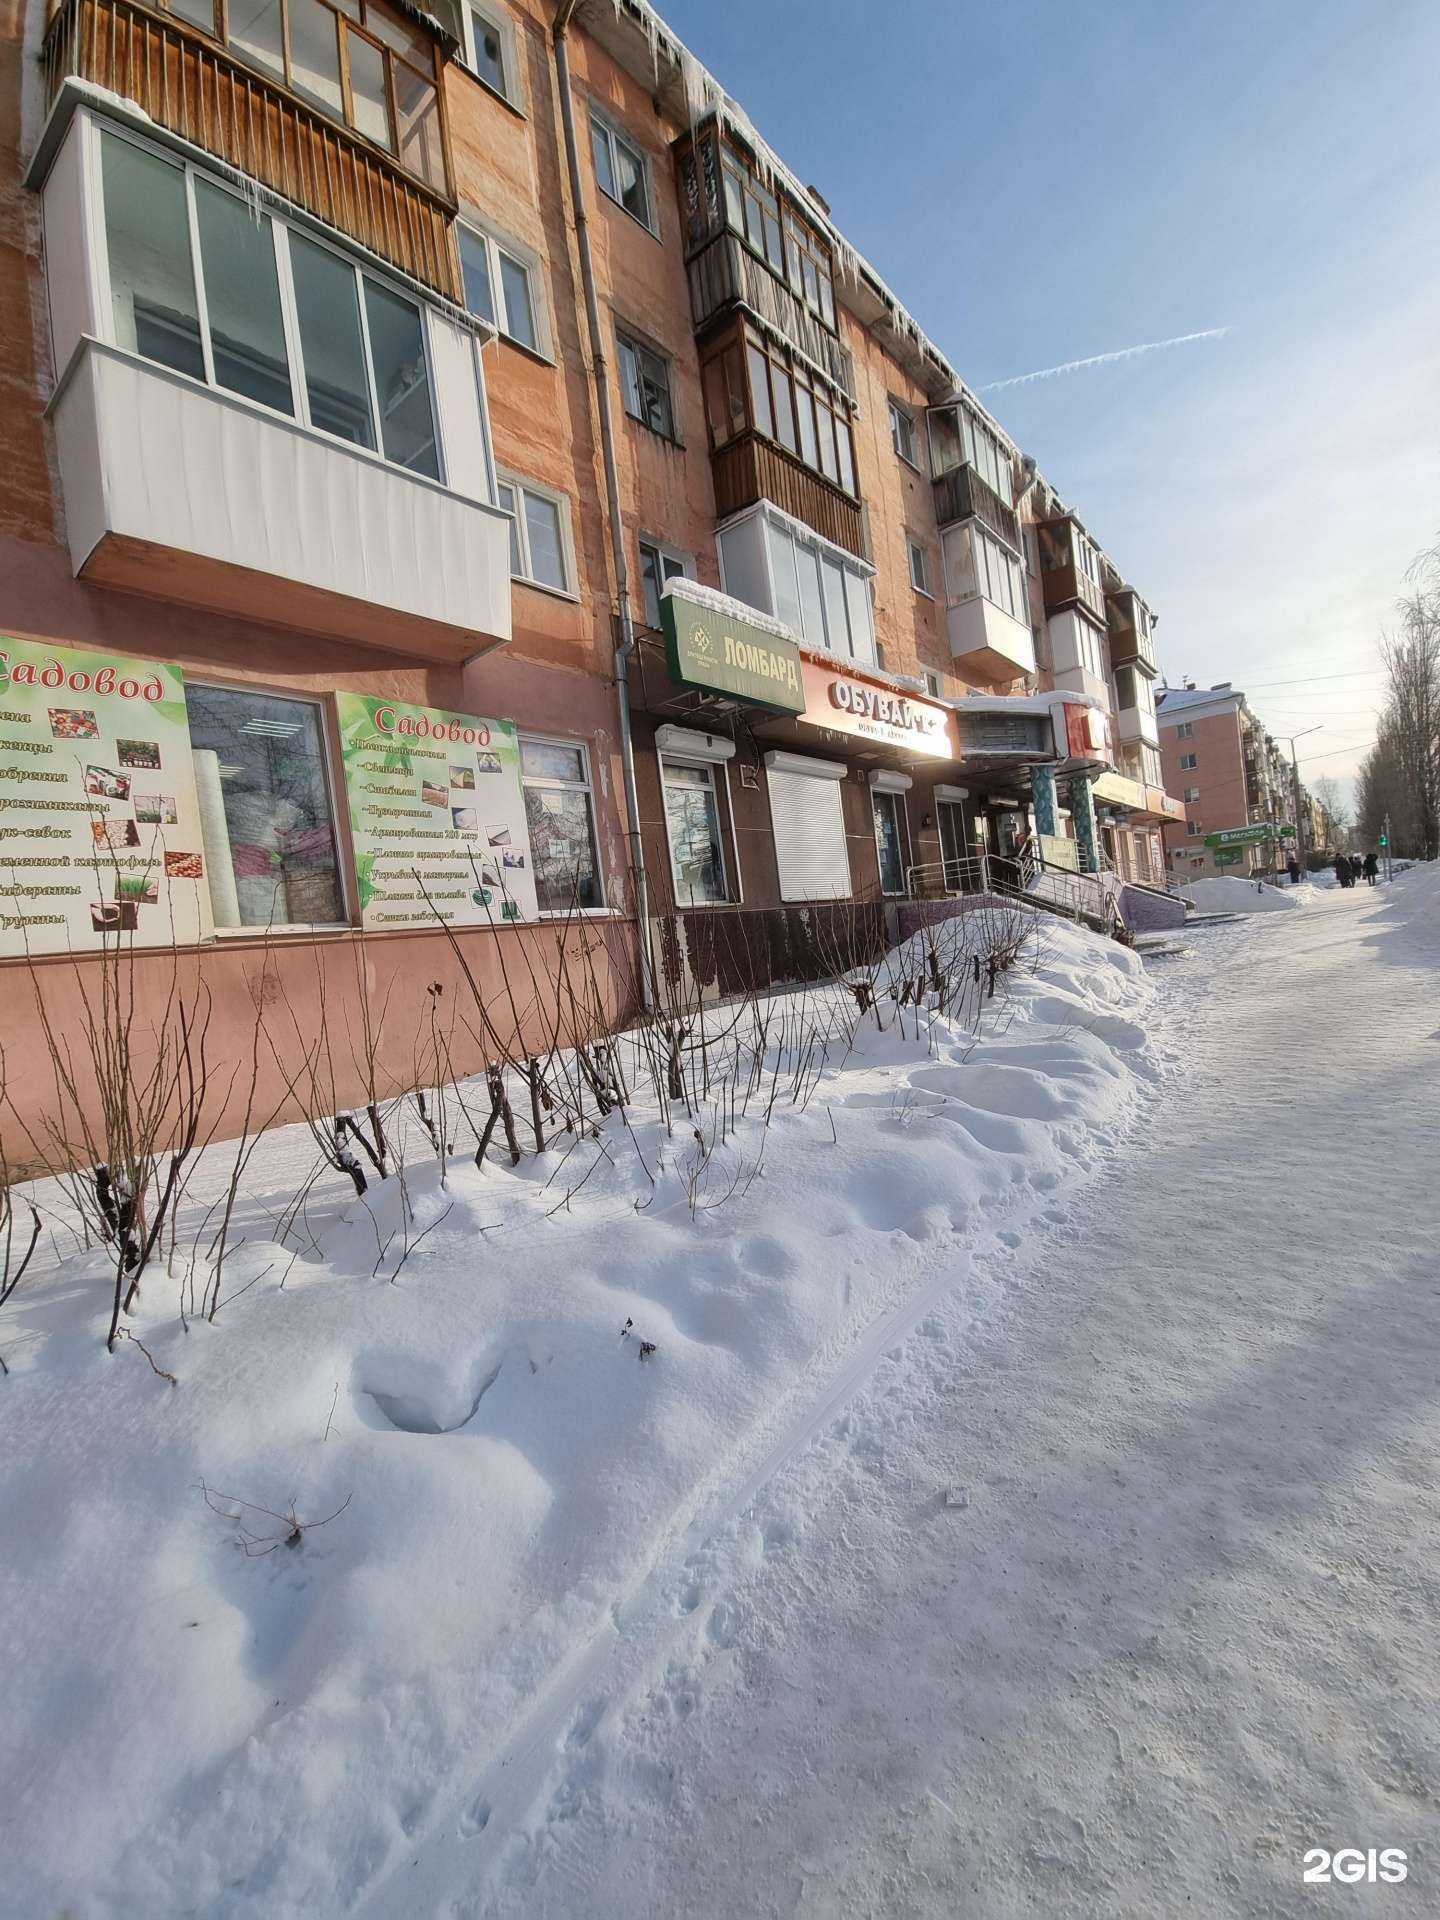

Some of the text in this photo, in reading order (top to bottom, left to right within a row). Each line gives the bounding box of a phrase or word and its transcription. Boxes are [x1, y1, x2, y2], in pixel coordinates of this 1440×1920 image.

[0, 651, 165, 702] адовод
[724, 636, 799, 692] ЛОМБАРД
[375, 707, 492, 746] Садовод
[74, 855, 162, 870] картофель
